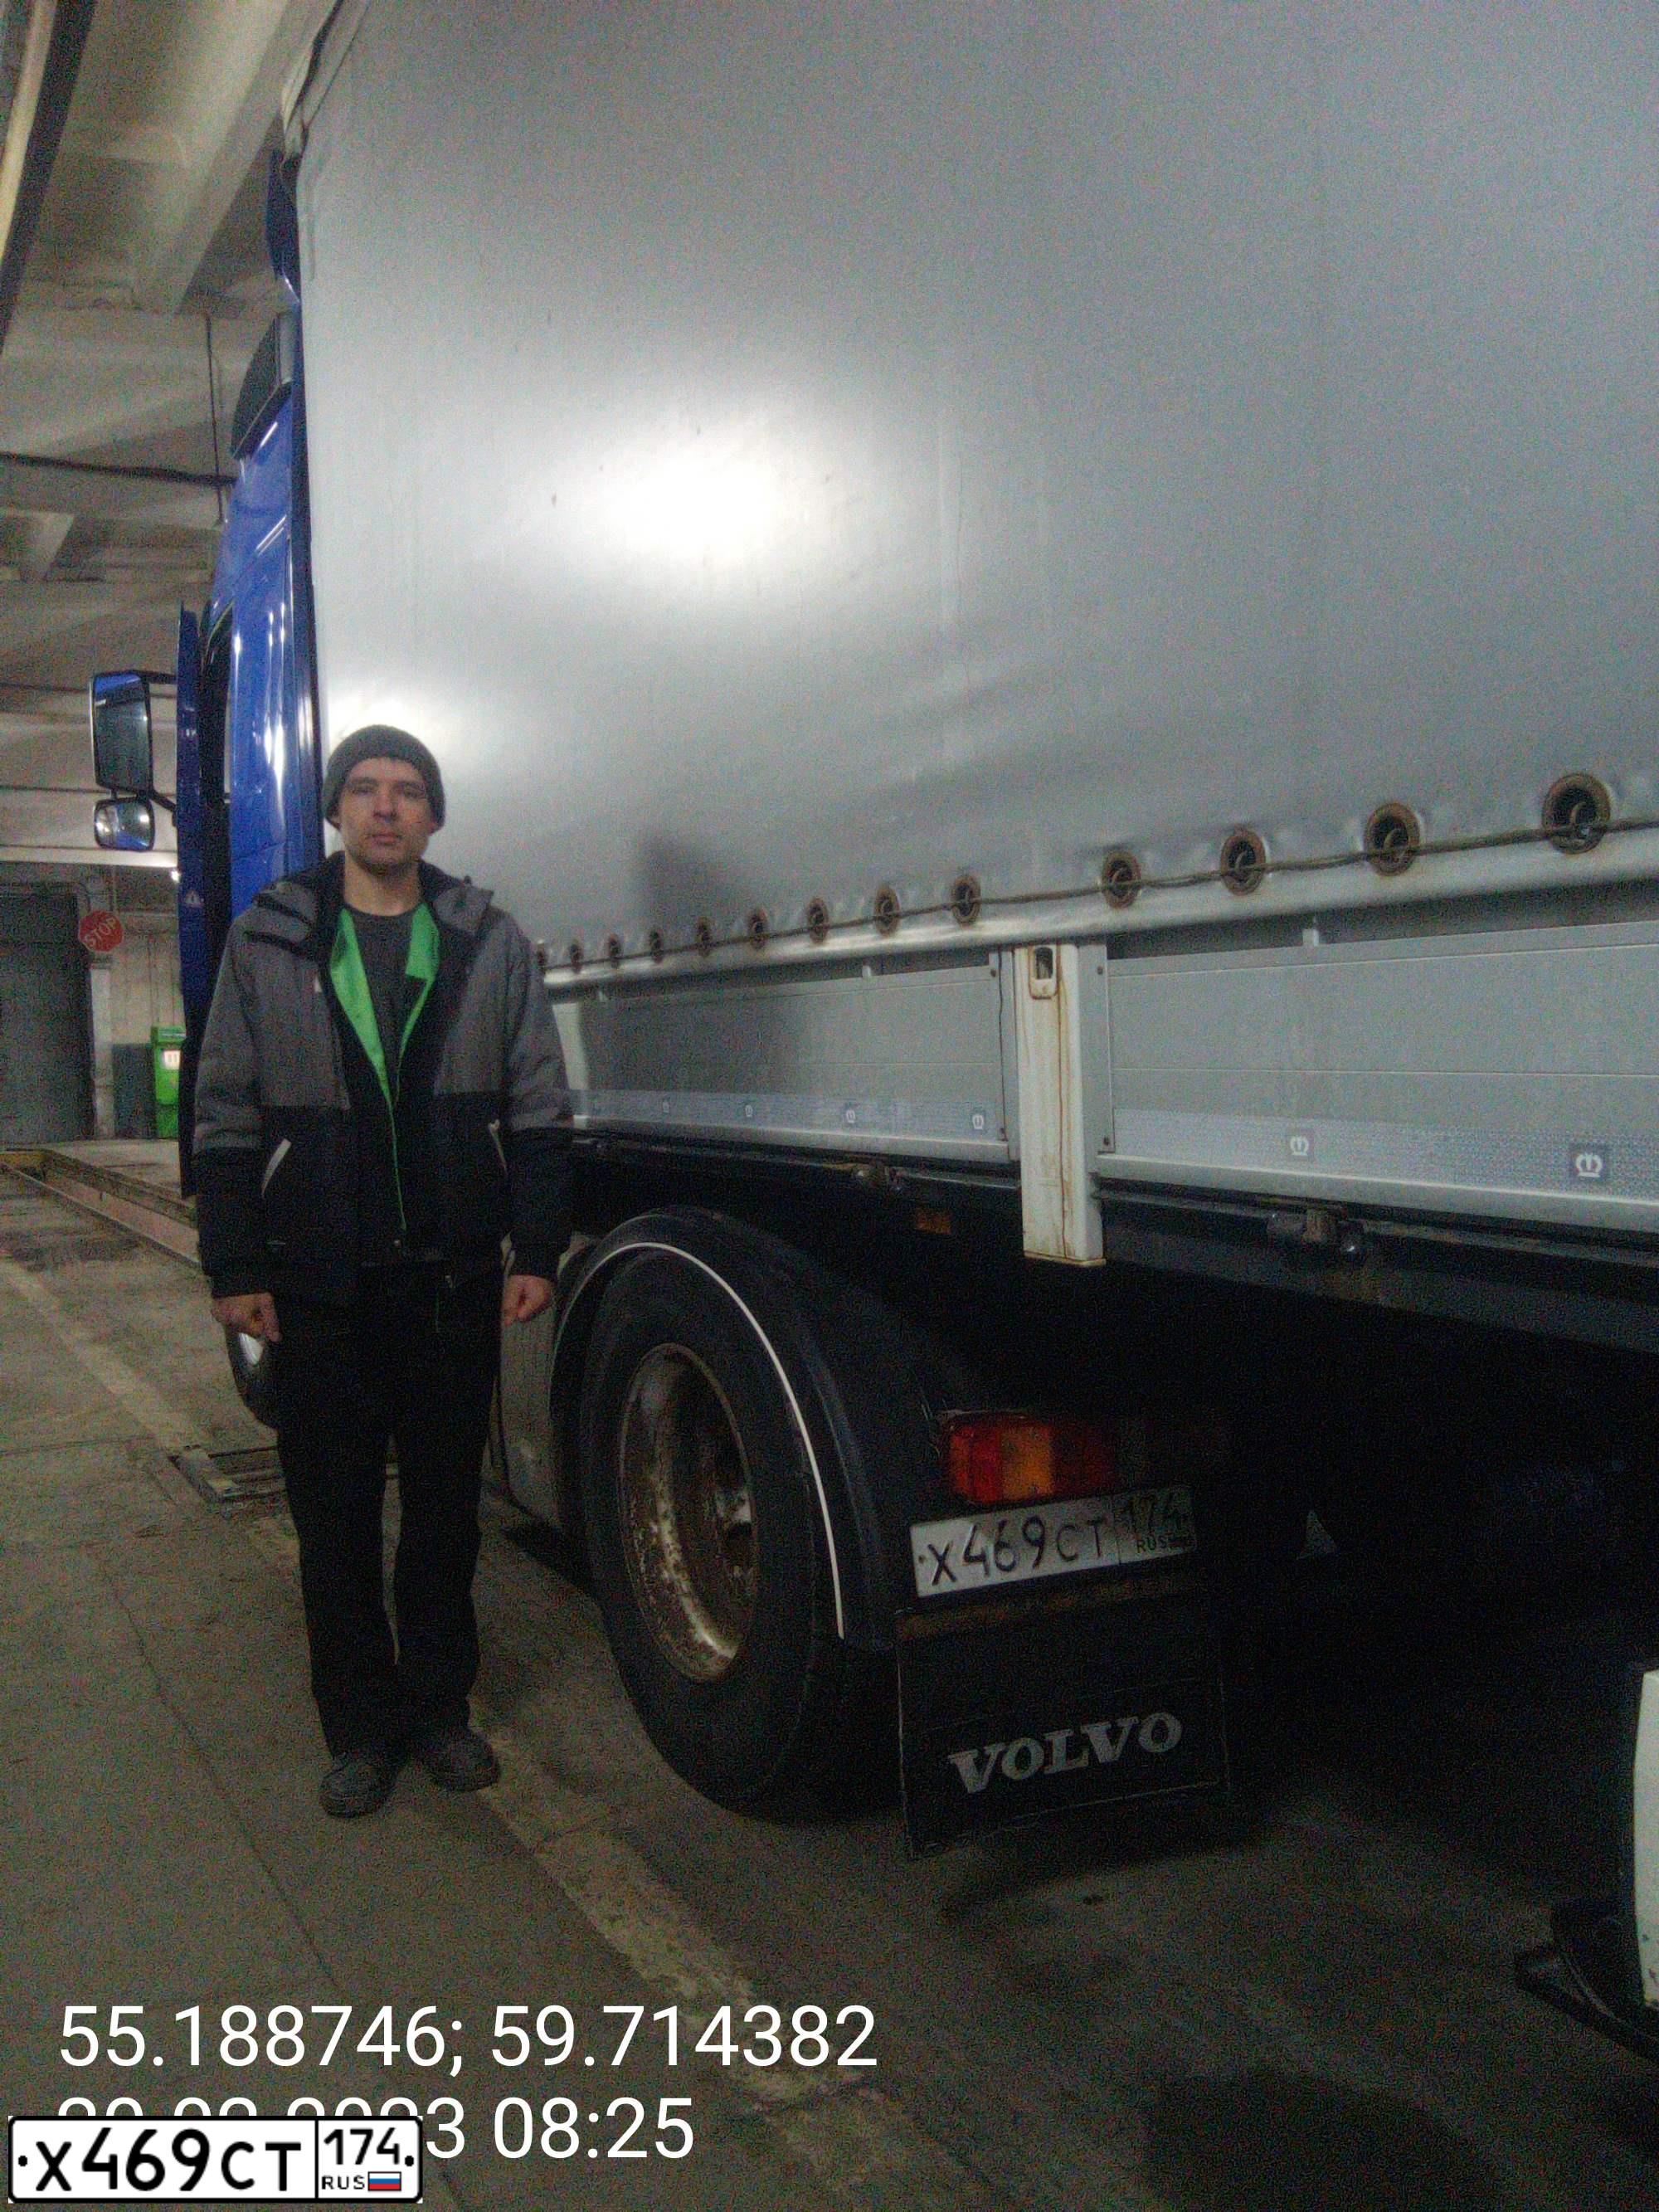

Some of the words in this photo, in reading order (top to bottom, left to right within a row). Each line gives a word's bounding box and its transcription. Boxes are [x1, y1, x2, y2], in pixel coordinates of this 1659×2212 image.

[85, 917, 116, 948] STOP
[1136, 1534, 1169, 1554] RUS
[948, 1712, 1183, 1794] VOLVO
